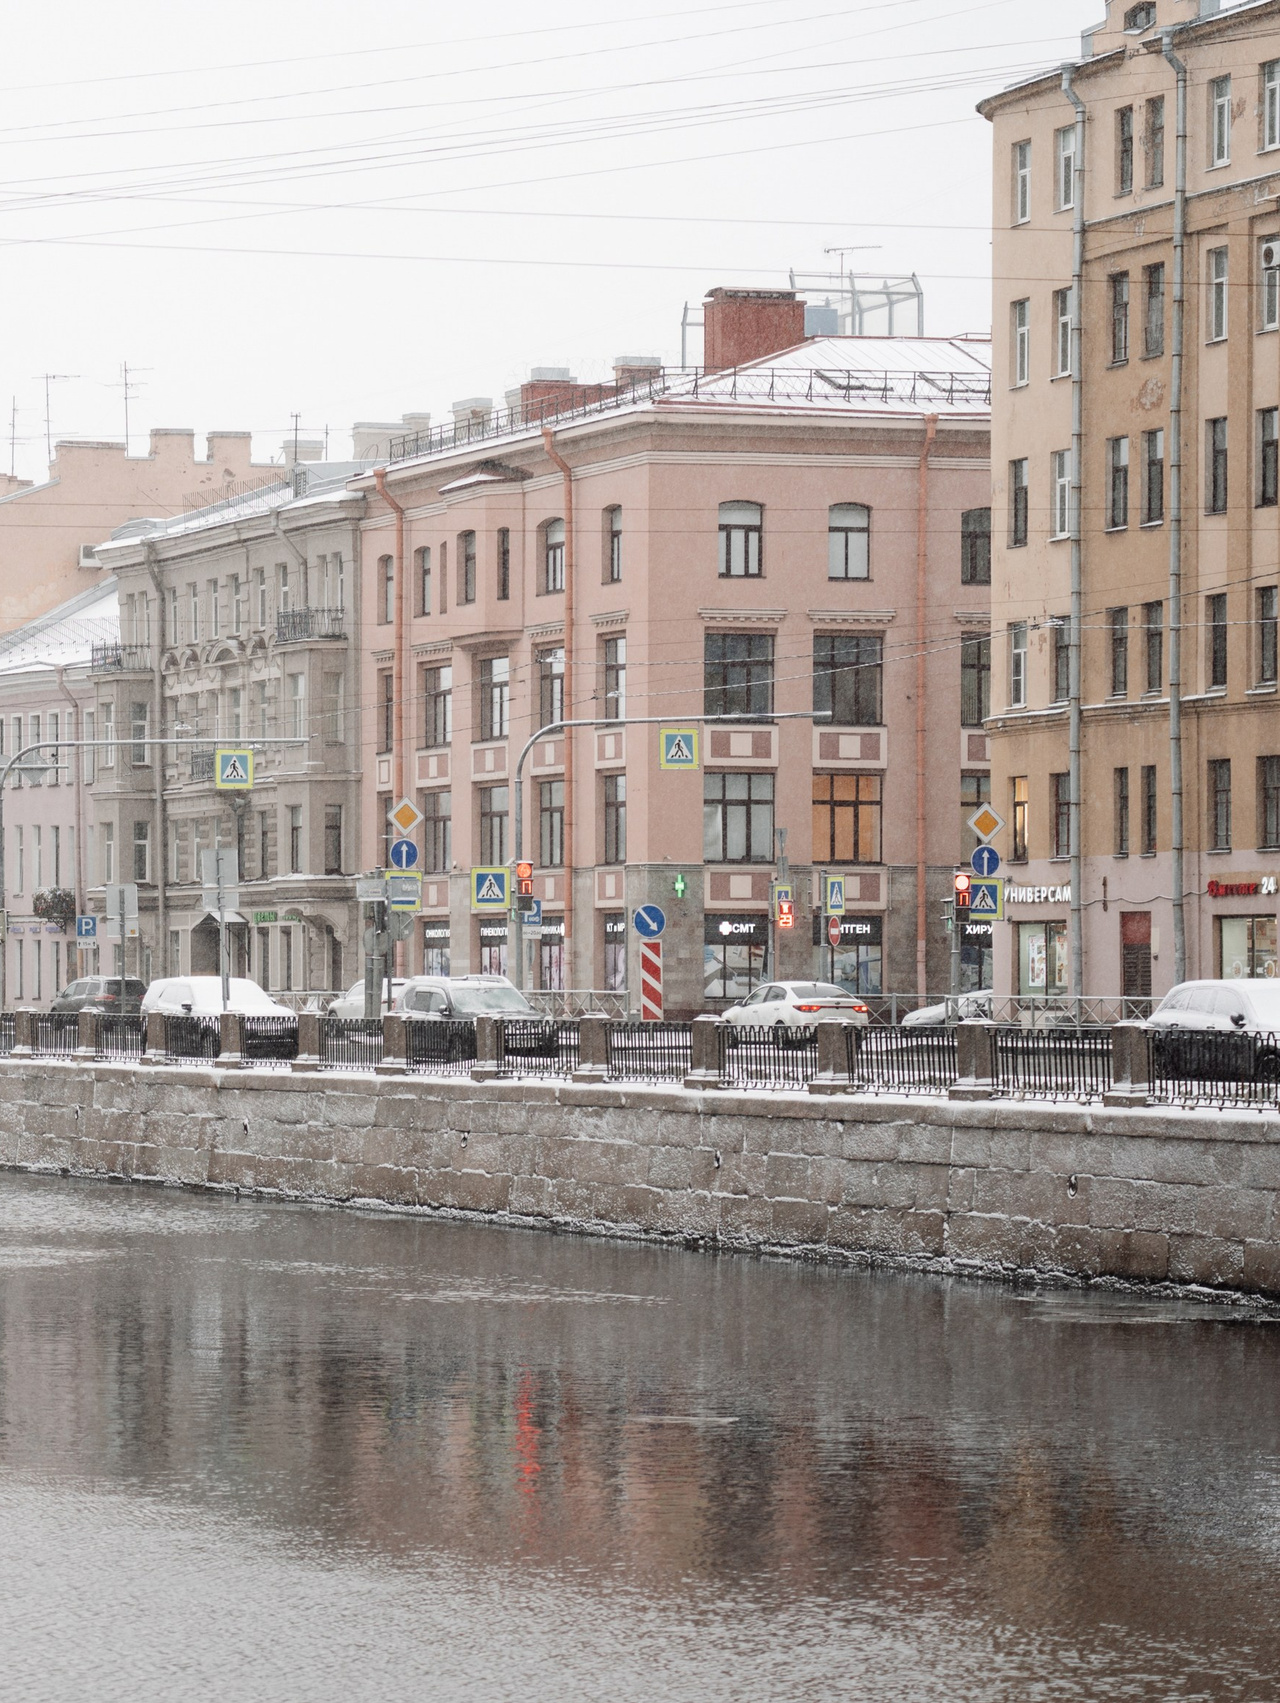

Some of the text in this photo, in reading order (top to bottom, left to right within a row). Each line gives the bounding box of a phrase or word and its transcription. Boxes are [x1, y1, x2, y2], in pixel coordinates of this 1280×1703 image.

[1261, 876, 1276, 894] 24
[1003, 886, 1071, 903] УНИВЕРСАМ
[82, 918, 93, 935] P
[732, 923, 755, 934] СМТ
[965, 924, 993, 935] ХИРУ
